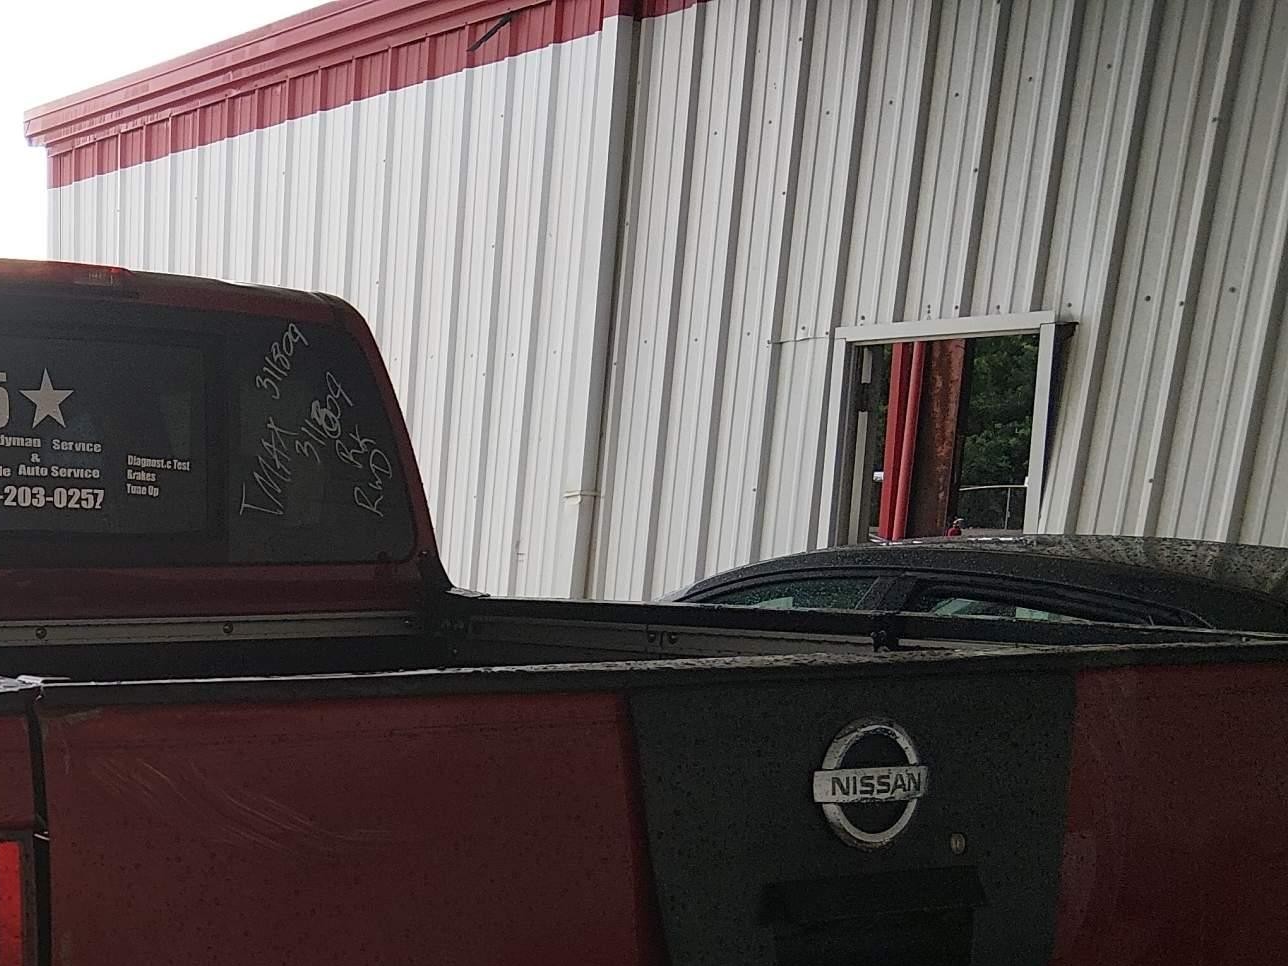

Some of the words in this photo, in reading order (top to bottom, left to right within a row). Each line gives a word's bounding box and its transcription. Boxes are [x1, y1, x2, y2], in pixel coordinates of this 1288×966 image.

[52, 438, 103, 453] Service
[30, 453, 40, 463] &
[172, 459, 191, 471] Test
[17, 464, 48, 477] Auto
[51, 465, 100, 478] Service
[127, 469, 156, 482] Brakes
[126, 483, 147, 495] Tune
[147, 485, 160, 497] Up
[831, 773, 921, 797] NISSAN
